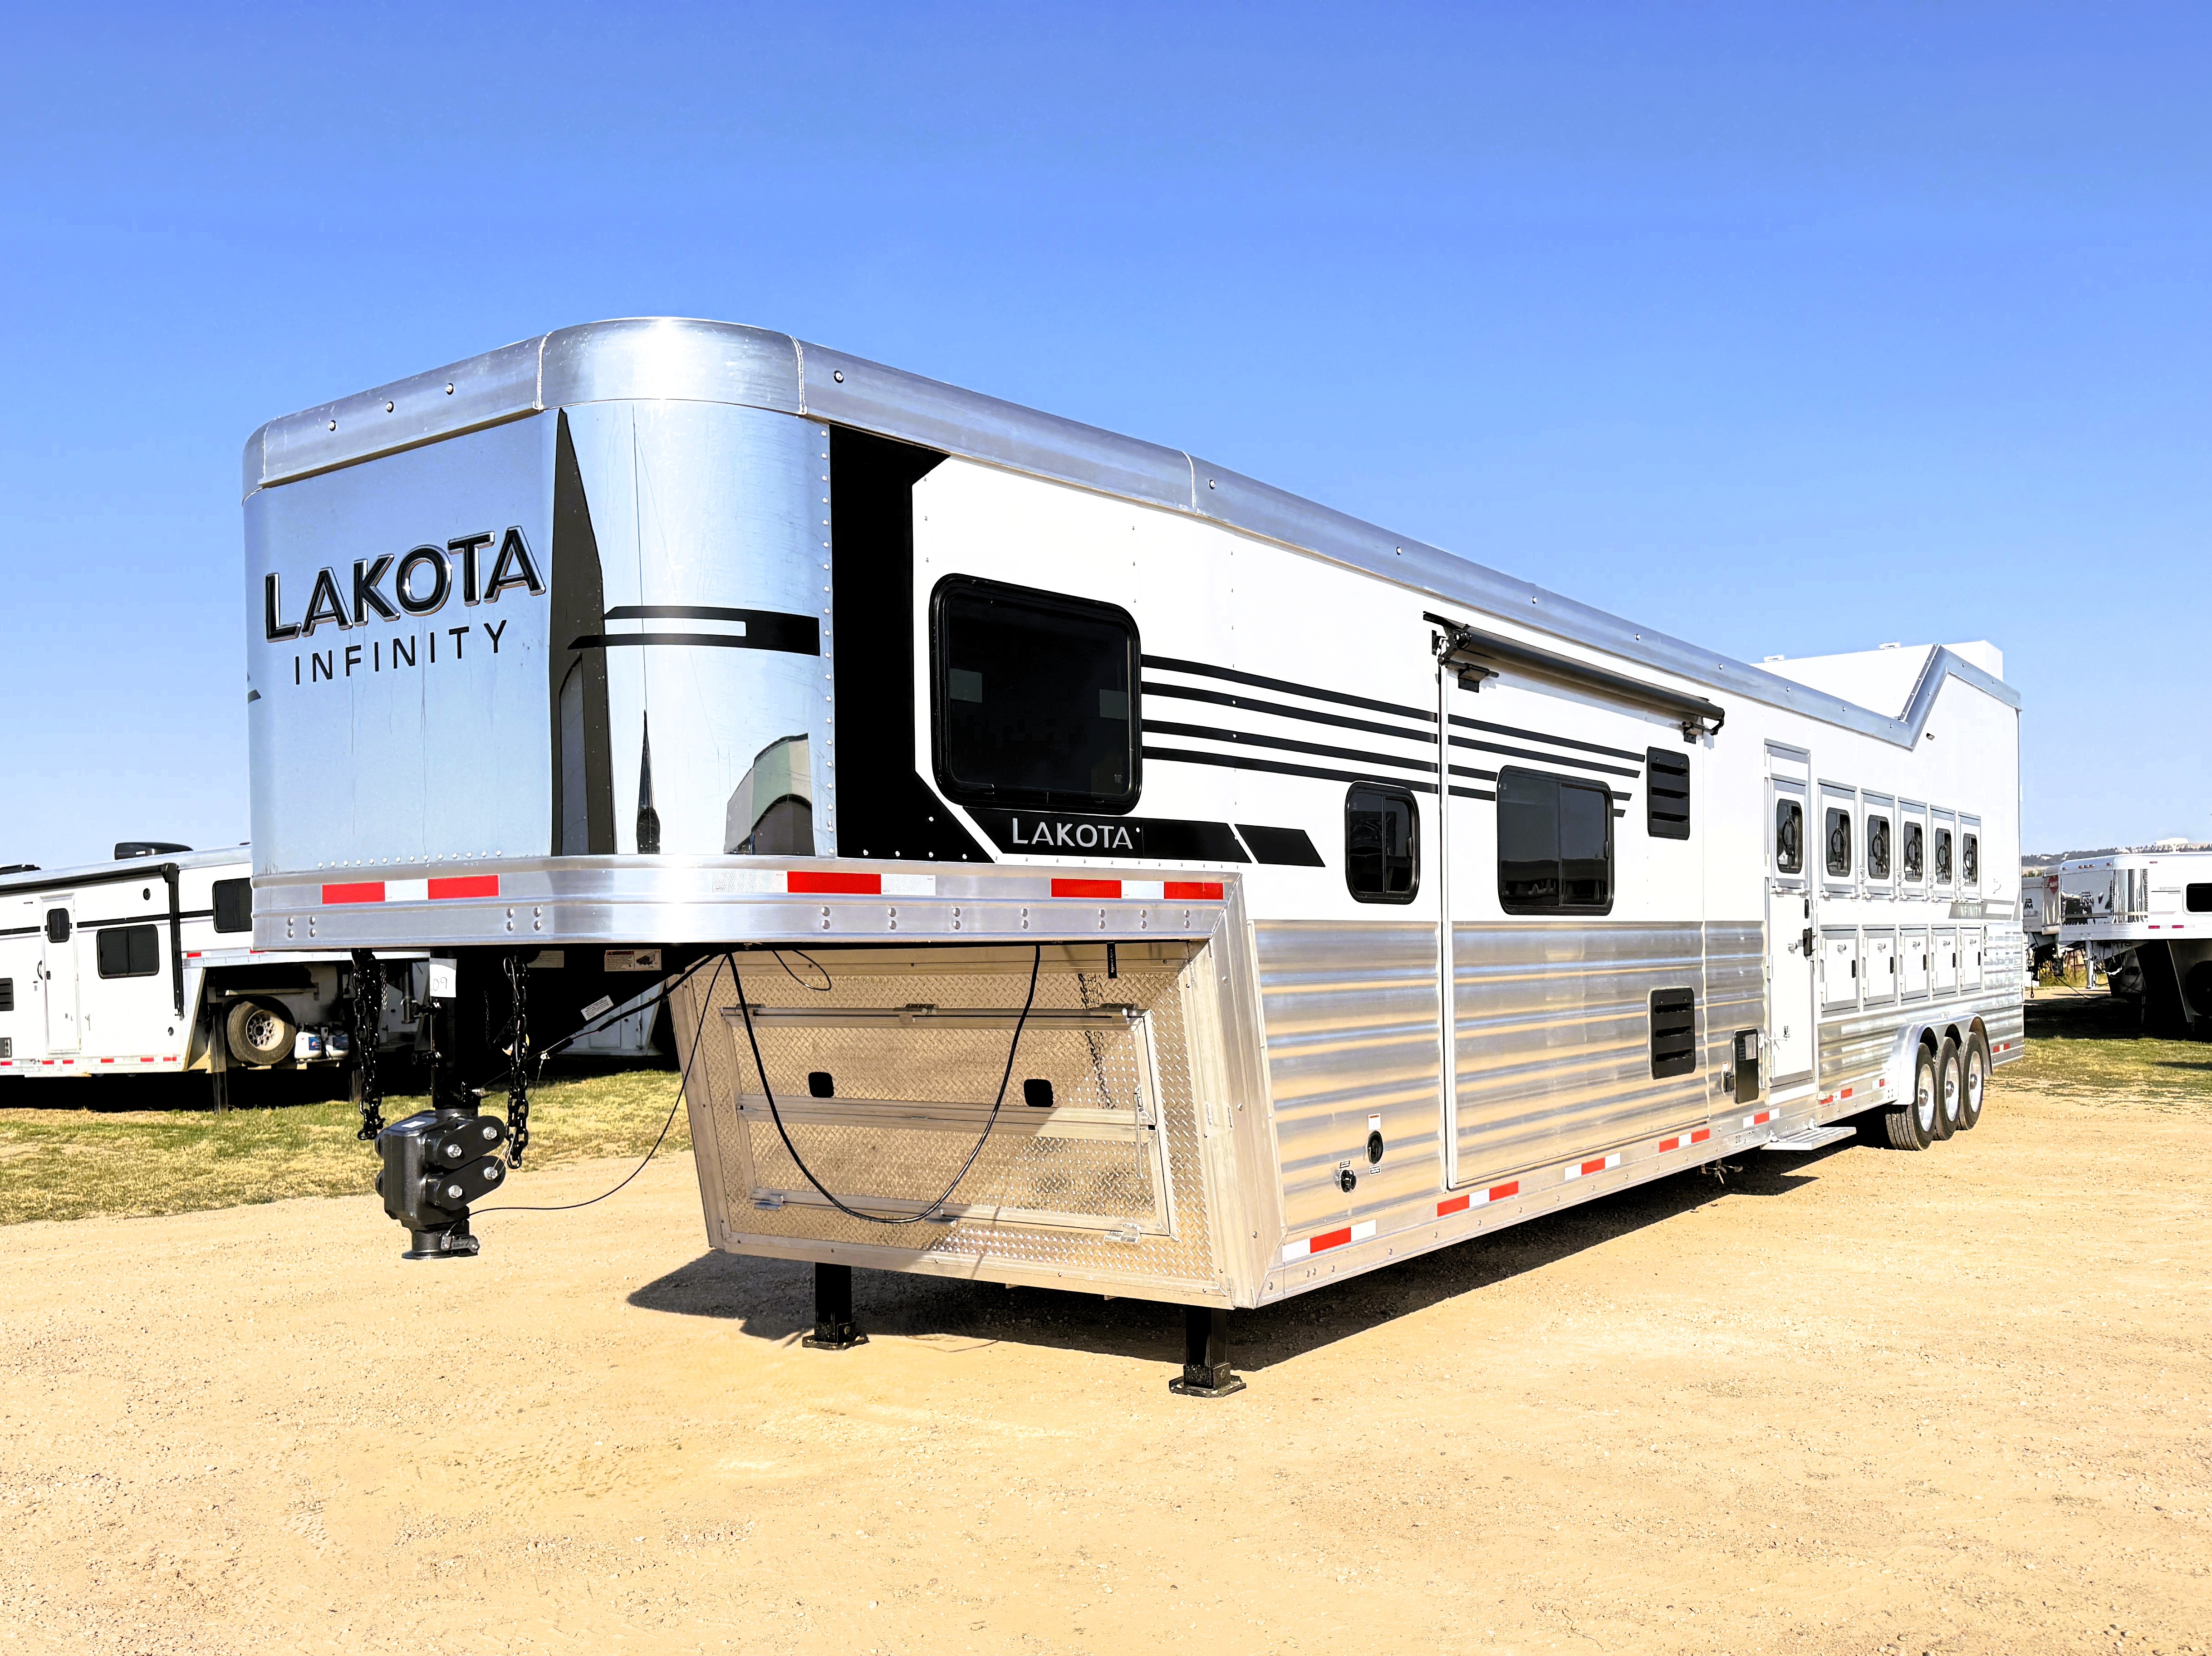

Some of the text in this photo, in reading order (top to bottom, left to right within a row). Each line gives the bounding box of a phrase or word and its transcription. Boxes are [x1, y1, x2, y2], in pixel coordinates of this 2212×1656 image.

[265, 525, 546, 643] LAKOTA
[295, 620, 507, 685] INFINITY
[1012, 818, 1133, 849] LAKOTA
[1958, 906, 1981, 917] INFINITY
